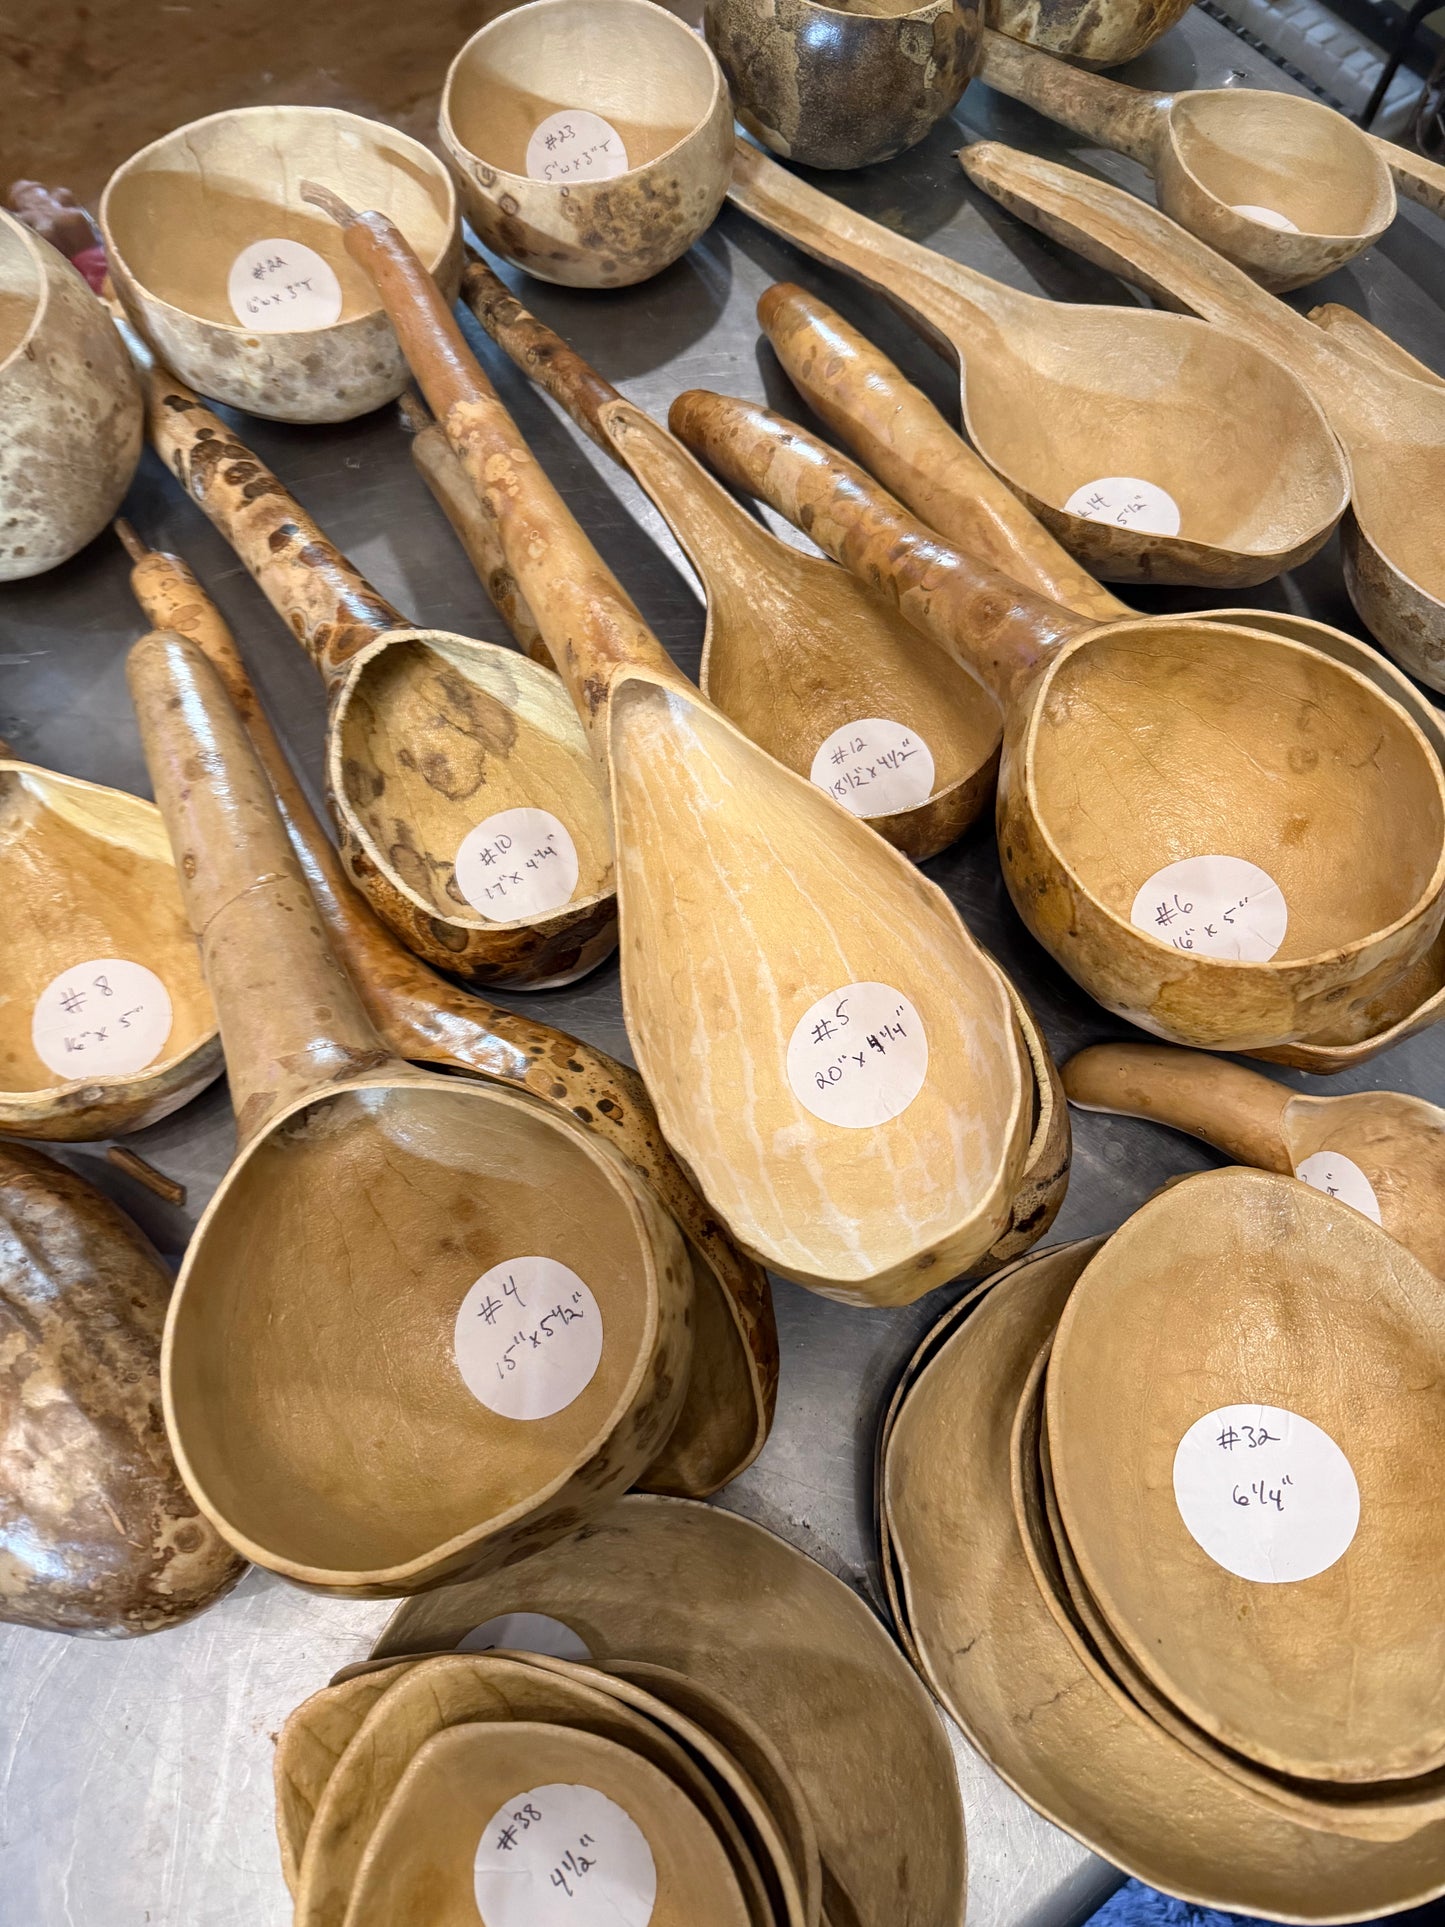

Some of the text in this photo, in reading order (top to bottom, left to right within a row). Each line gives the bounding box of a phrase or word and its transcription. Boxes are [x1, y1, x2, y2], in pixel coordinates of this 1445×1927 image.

[545, 125, 575, 151] #23
[830, 738, 868, 765] #12
[480, 834, 512, 866] #10
[1155, 895, 1194, 926] #6
[1223, 897, 1249, 923] 5"
[811, 998, 850, 1044] #5
[815, 1055, 847, 1089] 20"
[477, 1275, 526, 1325] #4
[496, 1331, 526, 1379] 15"
[1216, 1426, 1281, 1451] #32
[497, 1803, 542, 1851] #38
